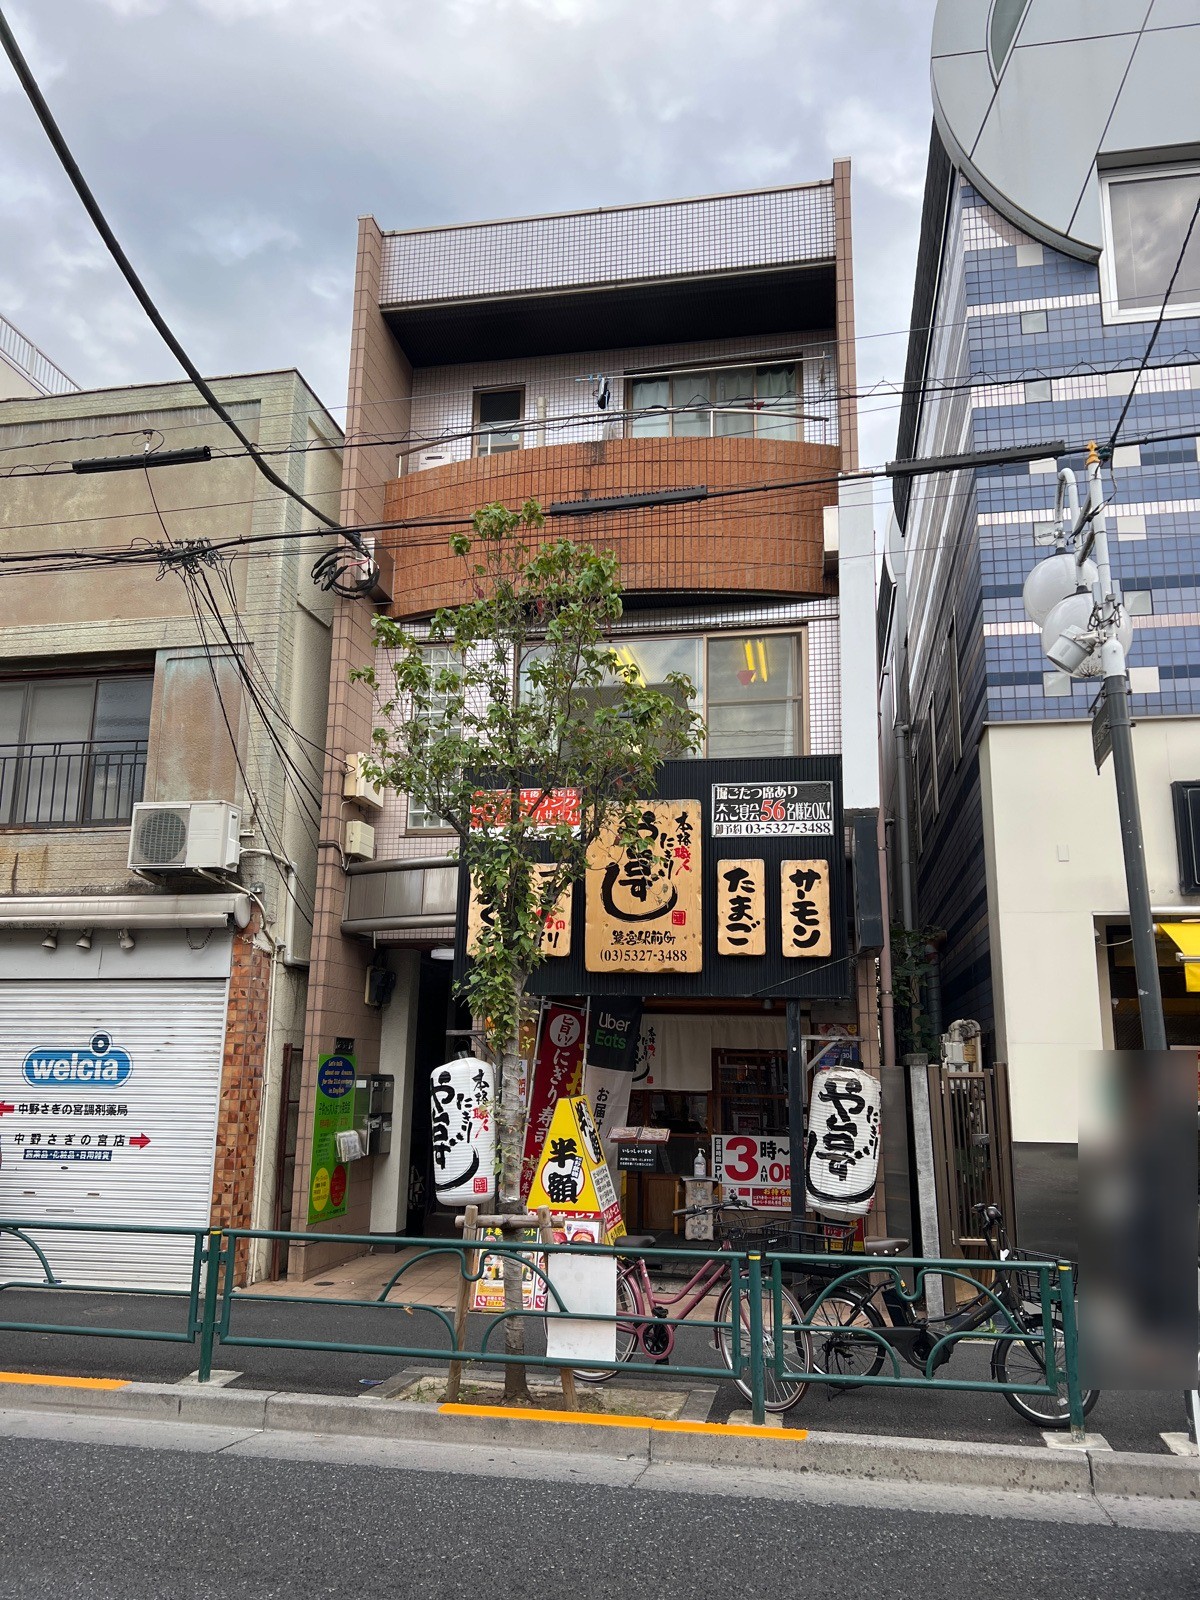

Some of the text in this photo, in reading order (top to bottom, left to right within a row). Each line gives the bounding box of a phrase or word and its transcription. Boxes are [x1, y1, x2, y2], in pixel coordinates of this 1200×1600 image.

[673, 811, 694, 876] 本格職人
[745, 822, 831, 834] 03-5327-3488
[723, 867, 761, 947] たまご
[788, 868, 822, 949] サーモン
[600, 949, 688, 963] (03)5327-3488
[598, 1011, 631, 1033] Uber
[32, 1034, 118, 1080] welcia
[595, 1030, 627, 1050] Eats
[18, 1103, 128, 1116] 中野さぎの宮調剤薬局
[457, 1093, 473, 1144] にぎり
[14, 1133, 126, 1147] 中野さぎの宮店
[548, 1137, 579, 1205] 半額
